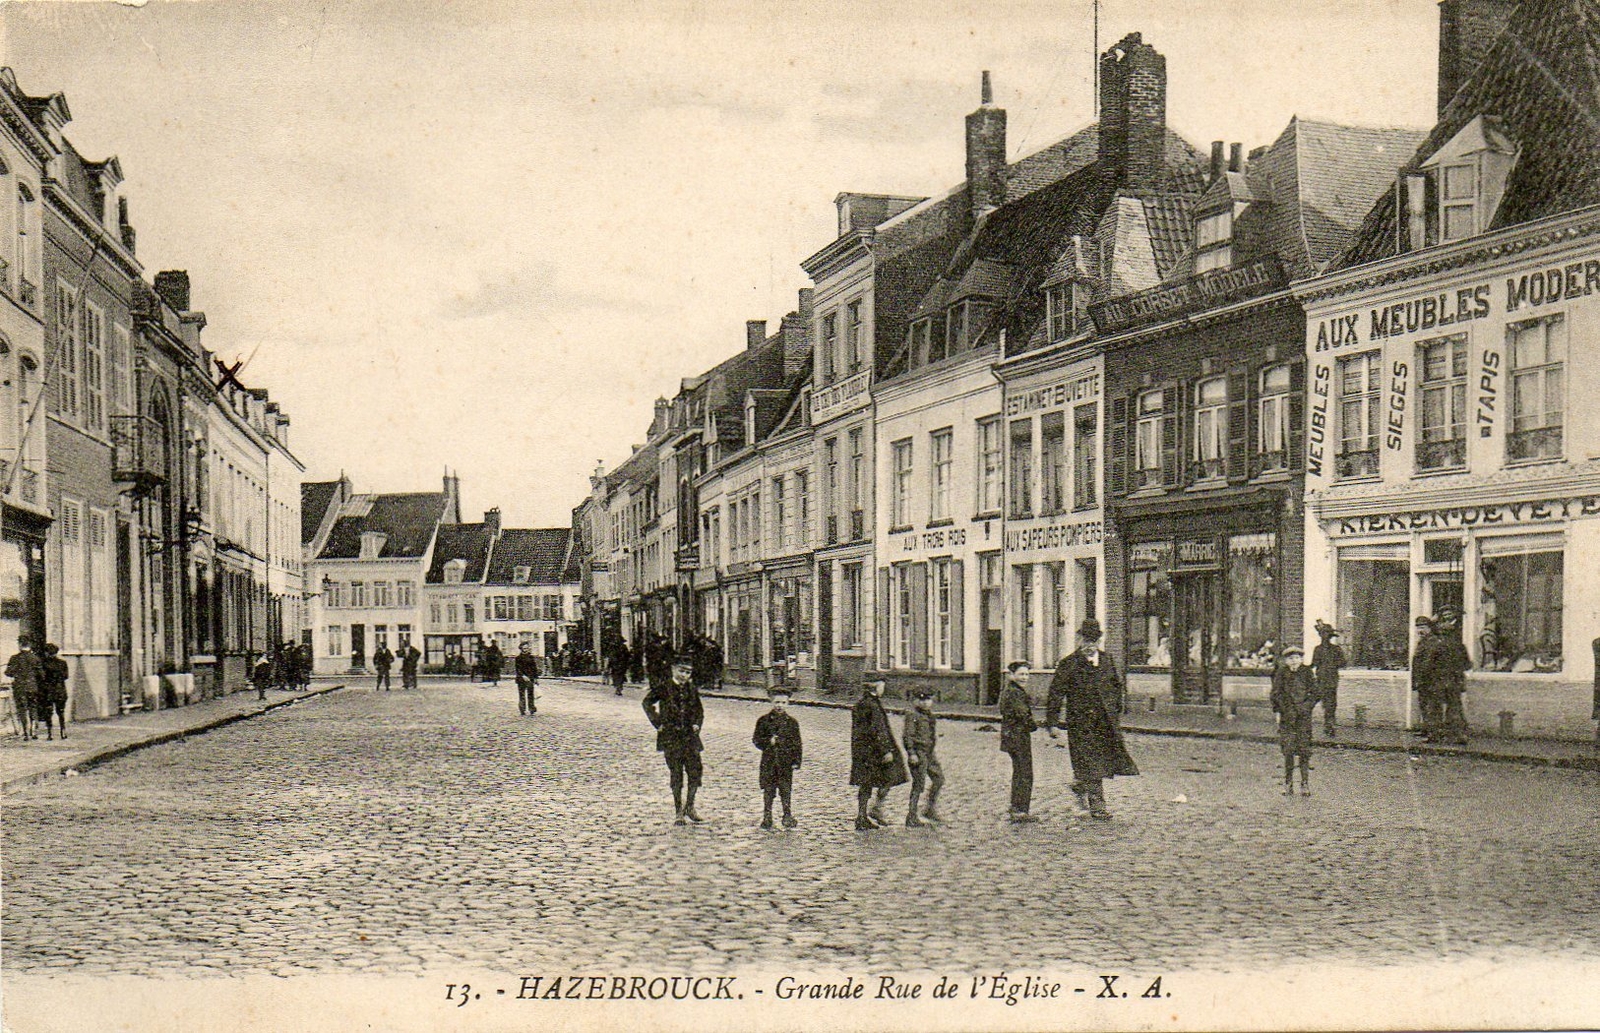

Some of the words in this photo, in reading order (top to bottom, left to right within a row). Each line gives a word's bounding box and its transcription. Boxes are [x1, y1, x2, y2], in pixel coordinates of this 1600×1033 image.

[1131, 284, 1190, 316] CORSET
[1196, 262, 1270, 299] MODELE
[1315, 313, 1359, 352] AUX
[1370, 284, 1492, 340] MEUBLES
[1506, 259, 1600, 312] MODER
[1308, 364, 1330, 477] MEUBLES
[1387, 360, 1408, 451] SIEGES
[1476, 349, 1500, 424] TAPIS
[903, 534, 918, 552] AUX
[922, 531, 945, 550] TROIS
[948, 528, 966, 546] ROIS
[1005, 530, 1020, 552] AUX
[1022, 525, 1059, 551] SAPEURS
[1061, 521, 1102, 548] POMPIERS
